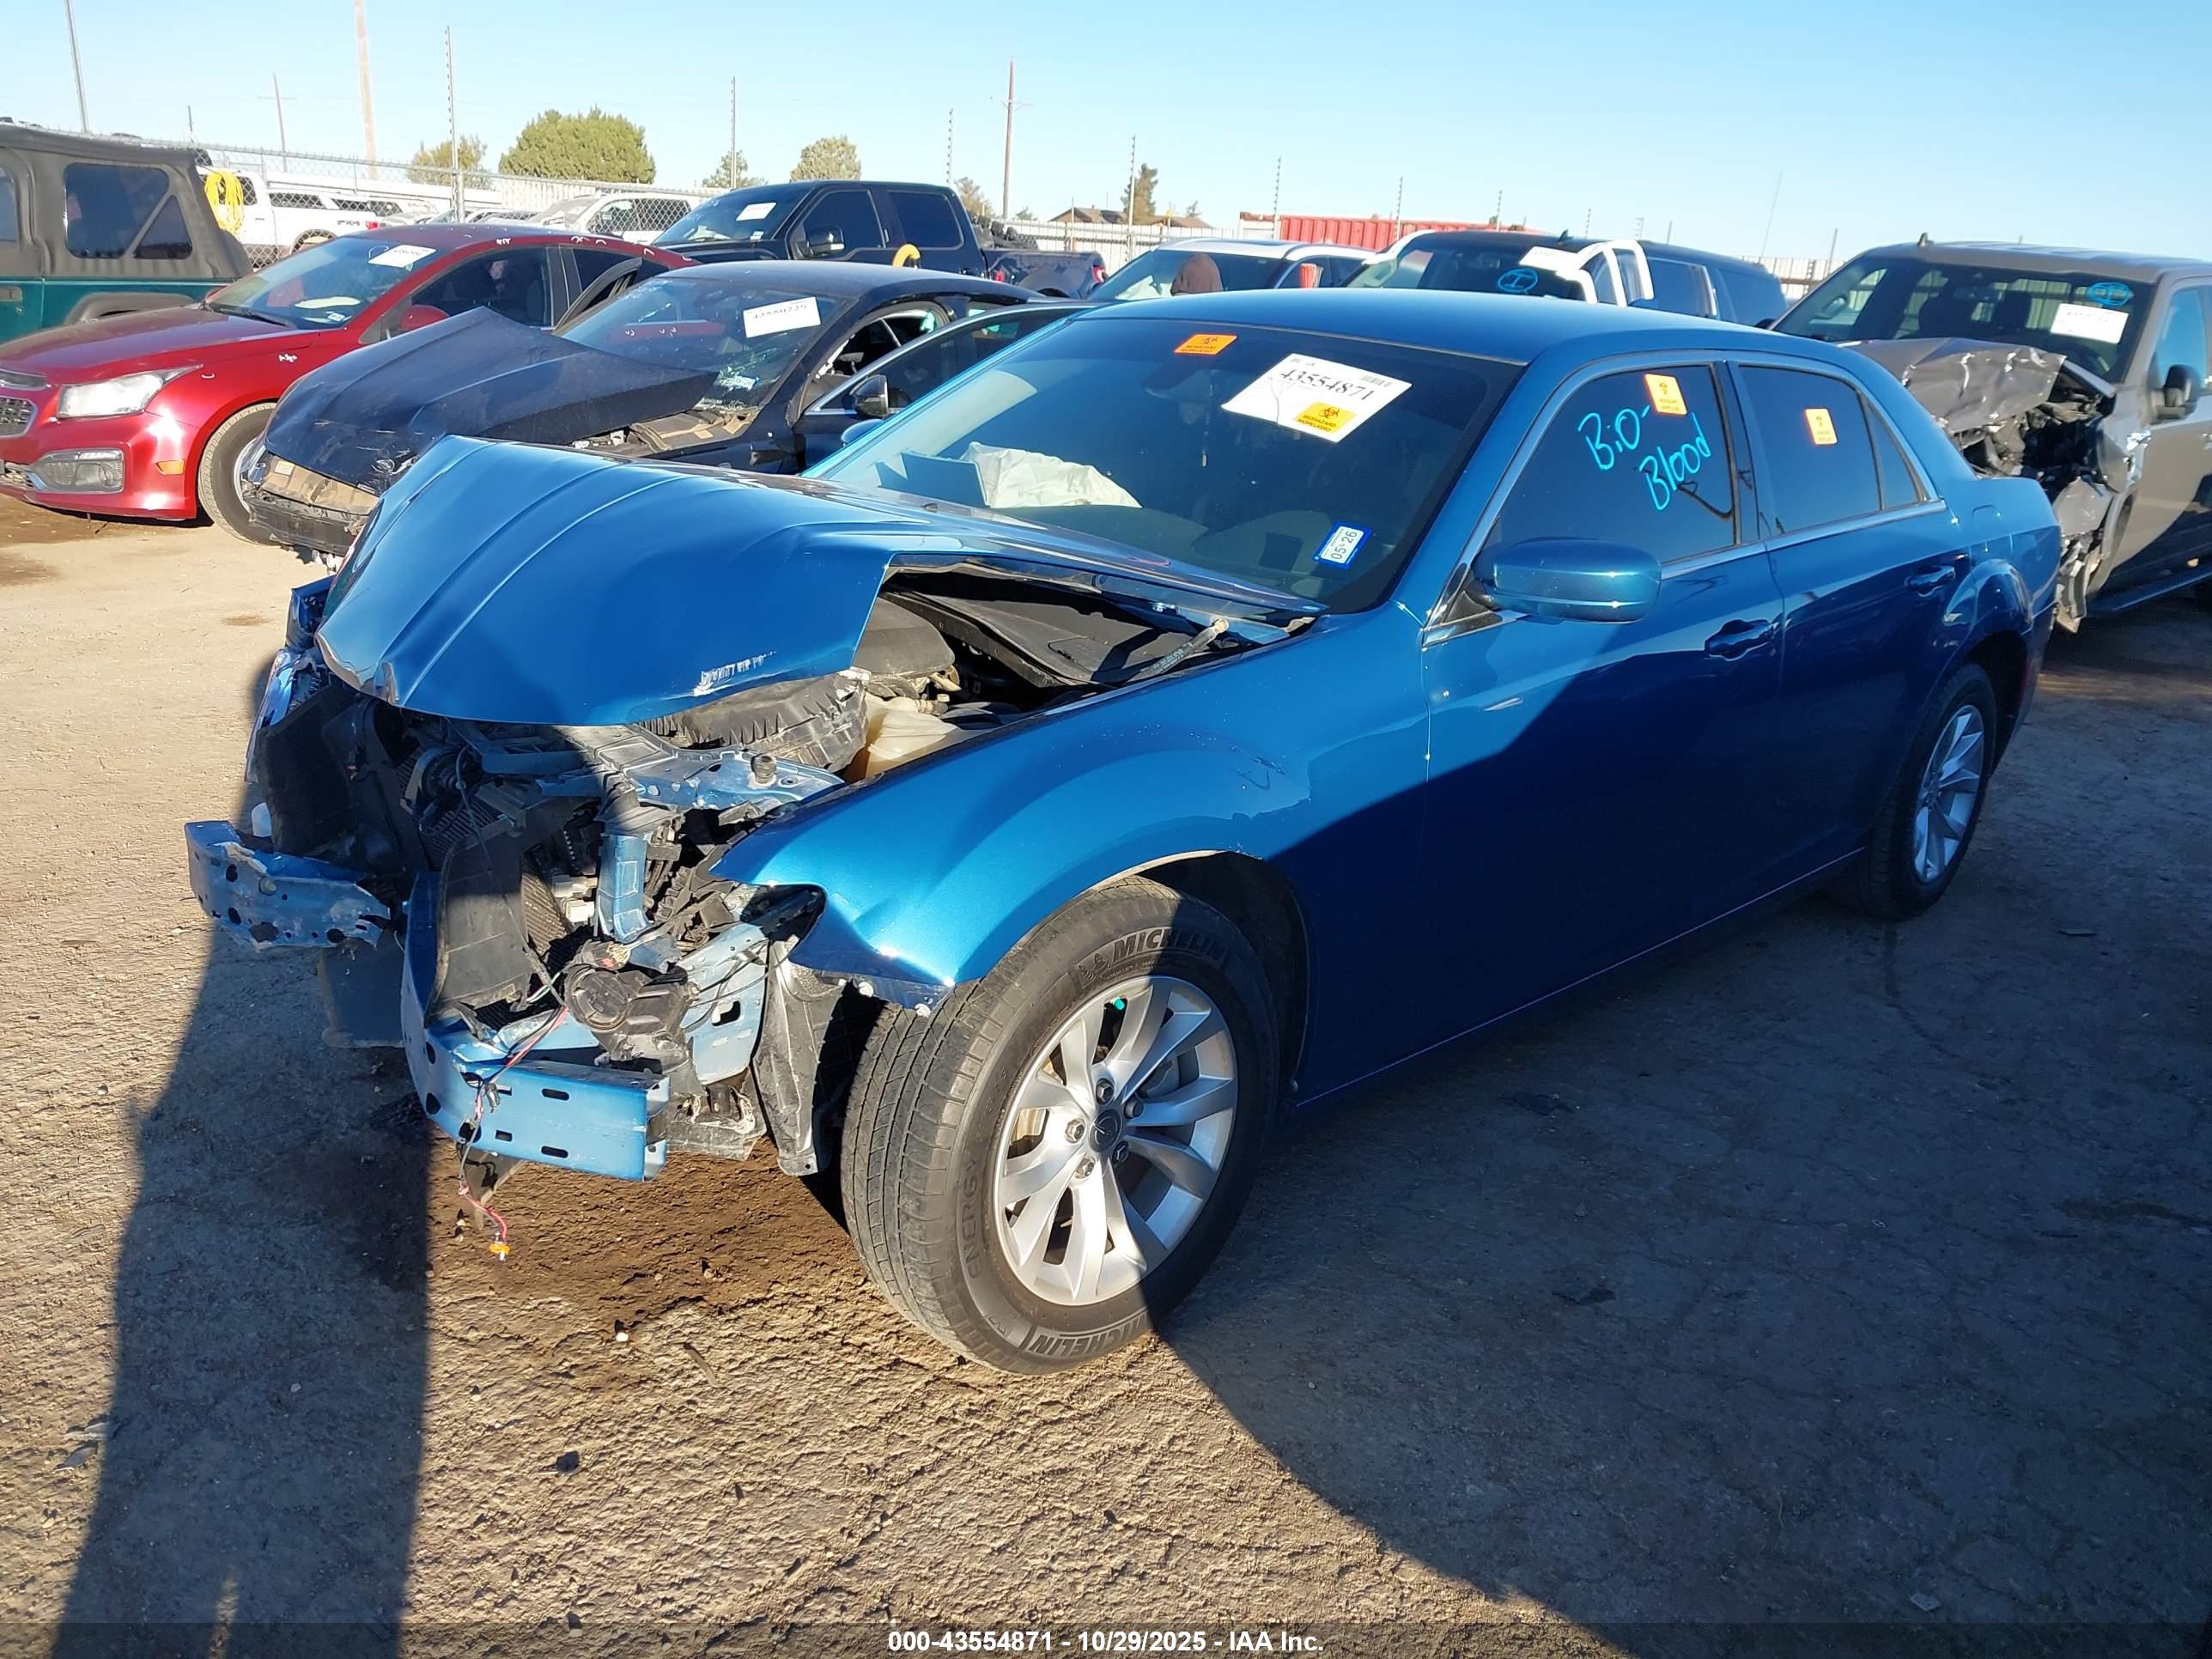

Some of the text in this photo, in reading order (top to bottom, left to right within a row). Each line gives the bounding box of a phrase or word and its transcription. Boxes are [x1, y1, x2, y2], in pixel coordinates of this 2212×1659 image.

[1280, 369, 1376, 401] 43554871
[1638, 411, 1713, 511] Blood
[1113, 928, 1228, 964] MICHELIN
[959, 1160, 983, 1279] ENERGY
[1029, 1309, 1149, 1357] MICHELIN
